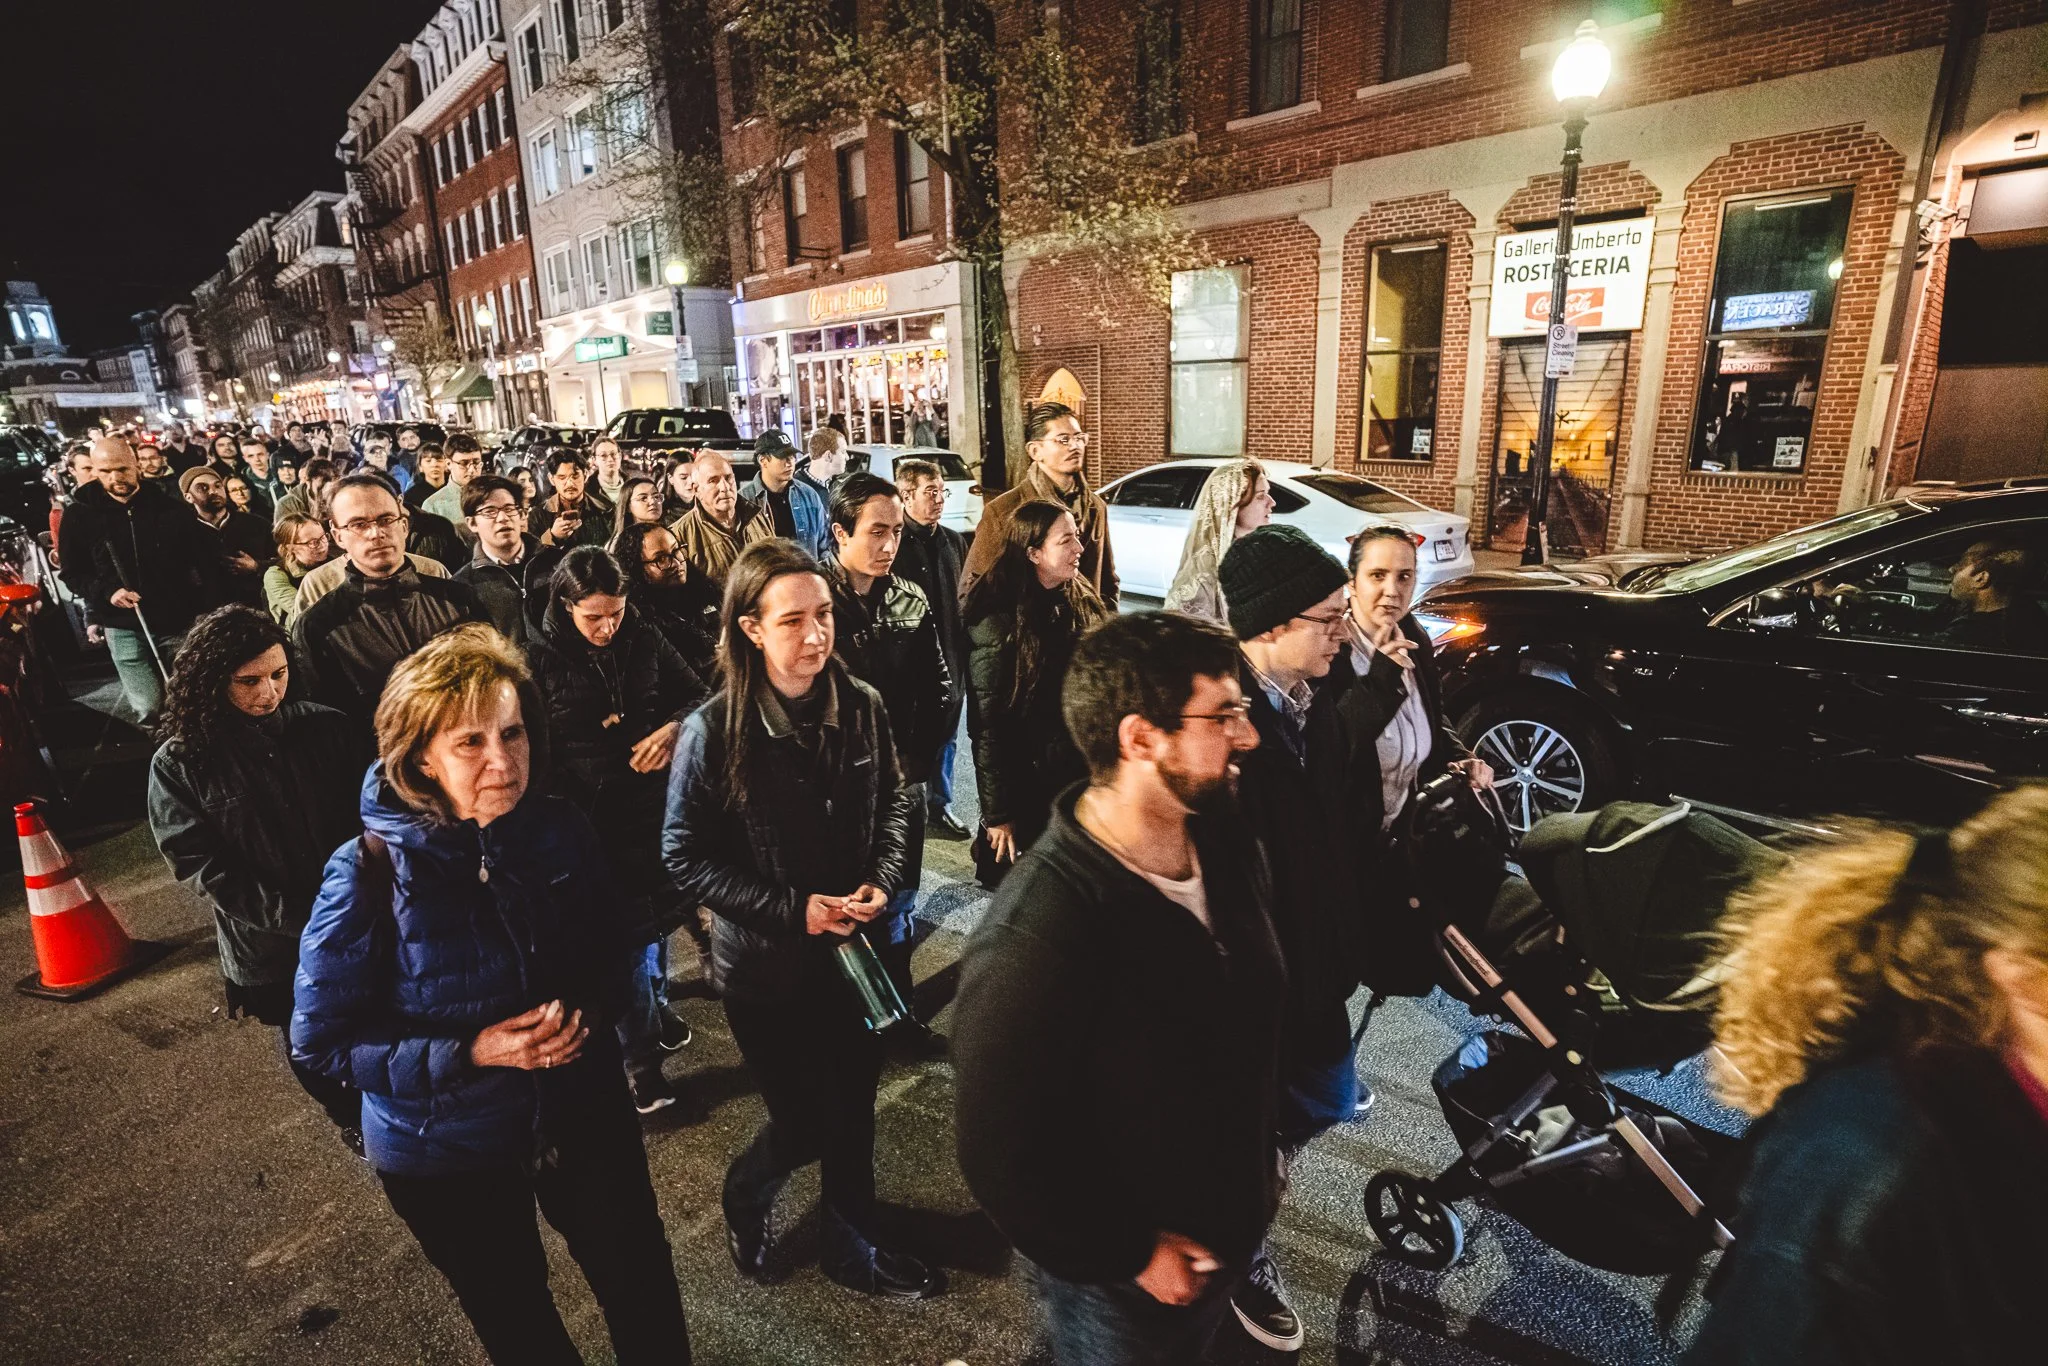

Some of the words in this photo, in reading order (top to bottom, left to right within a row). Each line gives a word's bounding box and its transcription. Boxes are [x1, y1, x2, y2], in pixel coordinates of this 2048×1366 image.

[1504, 238, 1556, 258] Galleri
[1570, 227, 1642, 251] Umberto
[1553, 342, 1570, 350] Street
